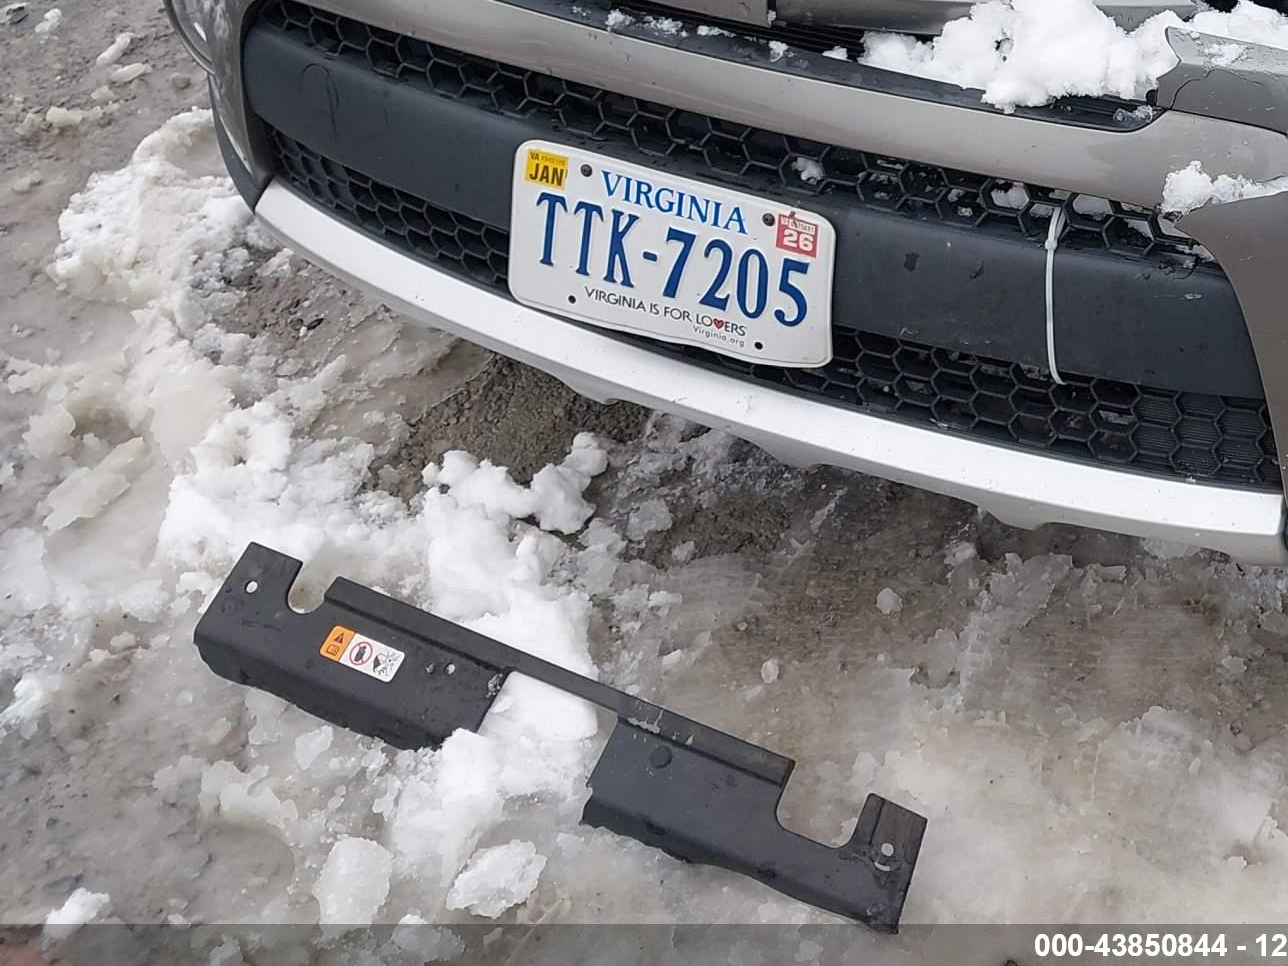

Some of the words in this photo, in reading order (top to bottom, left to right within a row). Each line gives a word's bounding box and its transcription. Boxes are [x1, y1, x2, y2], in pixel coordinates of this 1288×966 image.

[529, 163, 564, 186] JAN
[601, 170, 748, 235] VIRGINIA
[783, 229, 814, 251] 26
[536, 192, 811, 328] TTK-7205
[584, 286, 646, 312] VIRGINIA
[649, 302, 660, 315] IS
[663, 306, 693, 322] FOR
